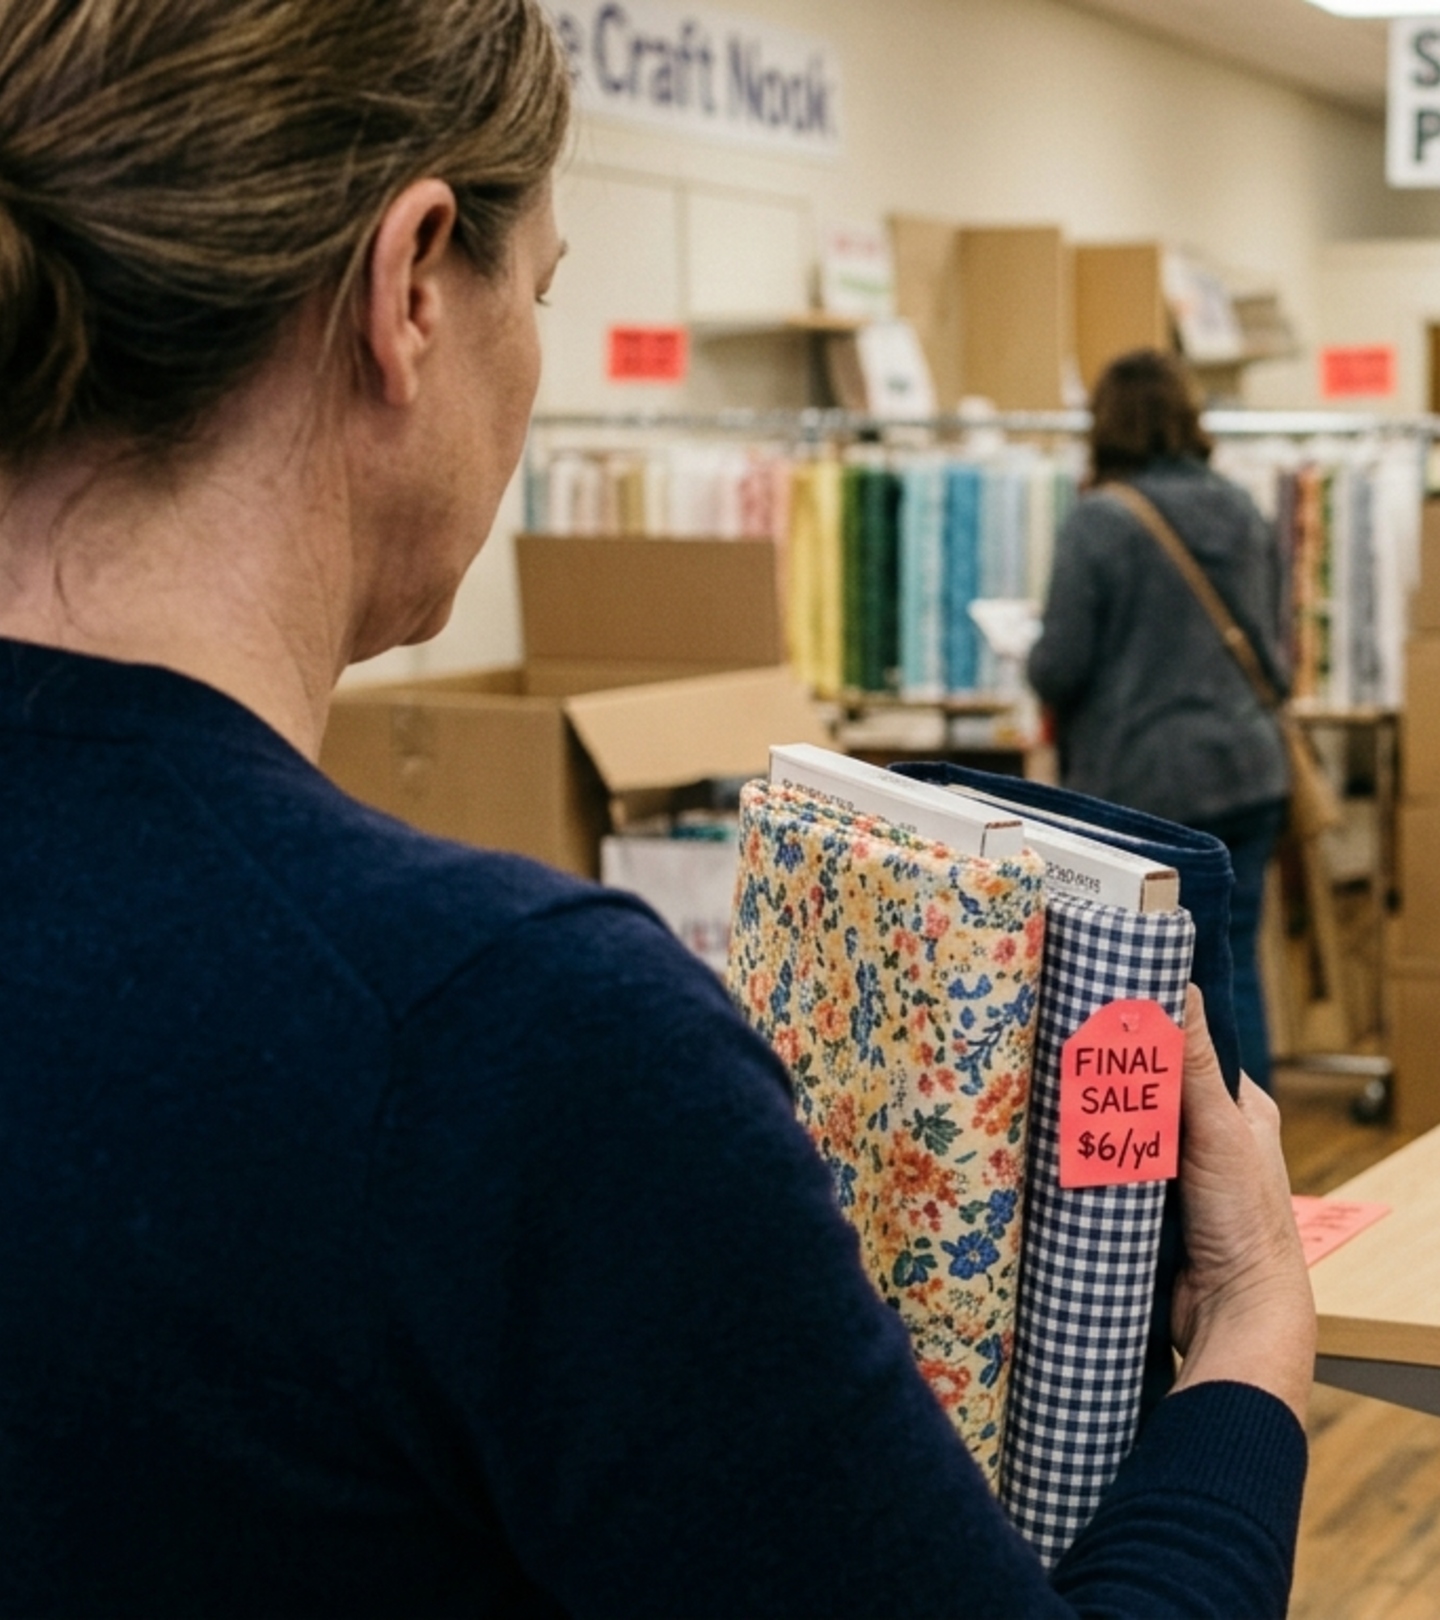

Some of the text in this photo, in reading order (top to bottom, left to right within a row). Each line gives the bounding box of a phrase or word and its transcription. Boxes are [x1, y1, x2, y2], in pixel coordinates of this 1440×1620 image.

[593, 2, 716, 116] Craft
[727, 30, 836, 138] Nook
[1075, 1046, 1169, 1077] FINAL
[1081, 1083, 1161, 1115] SALE
[1077, 1127, 1161, 1170] $6/yd
